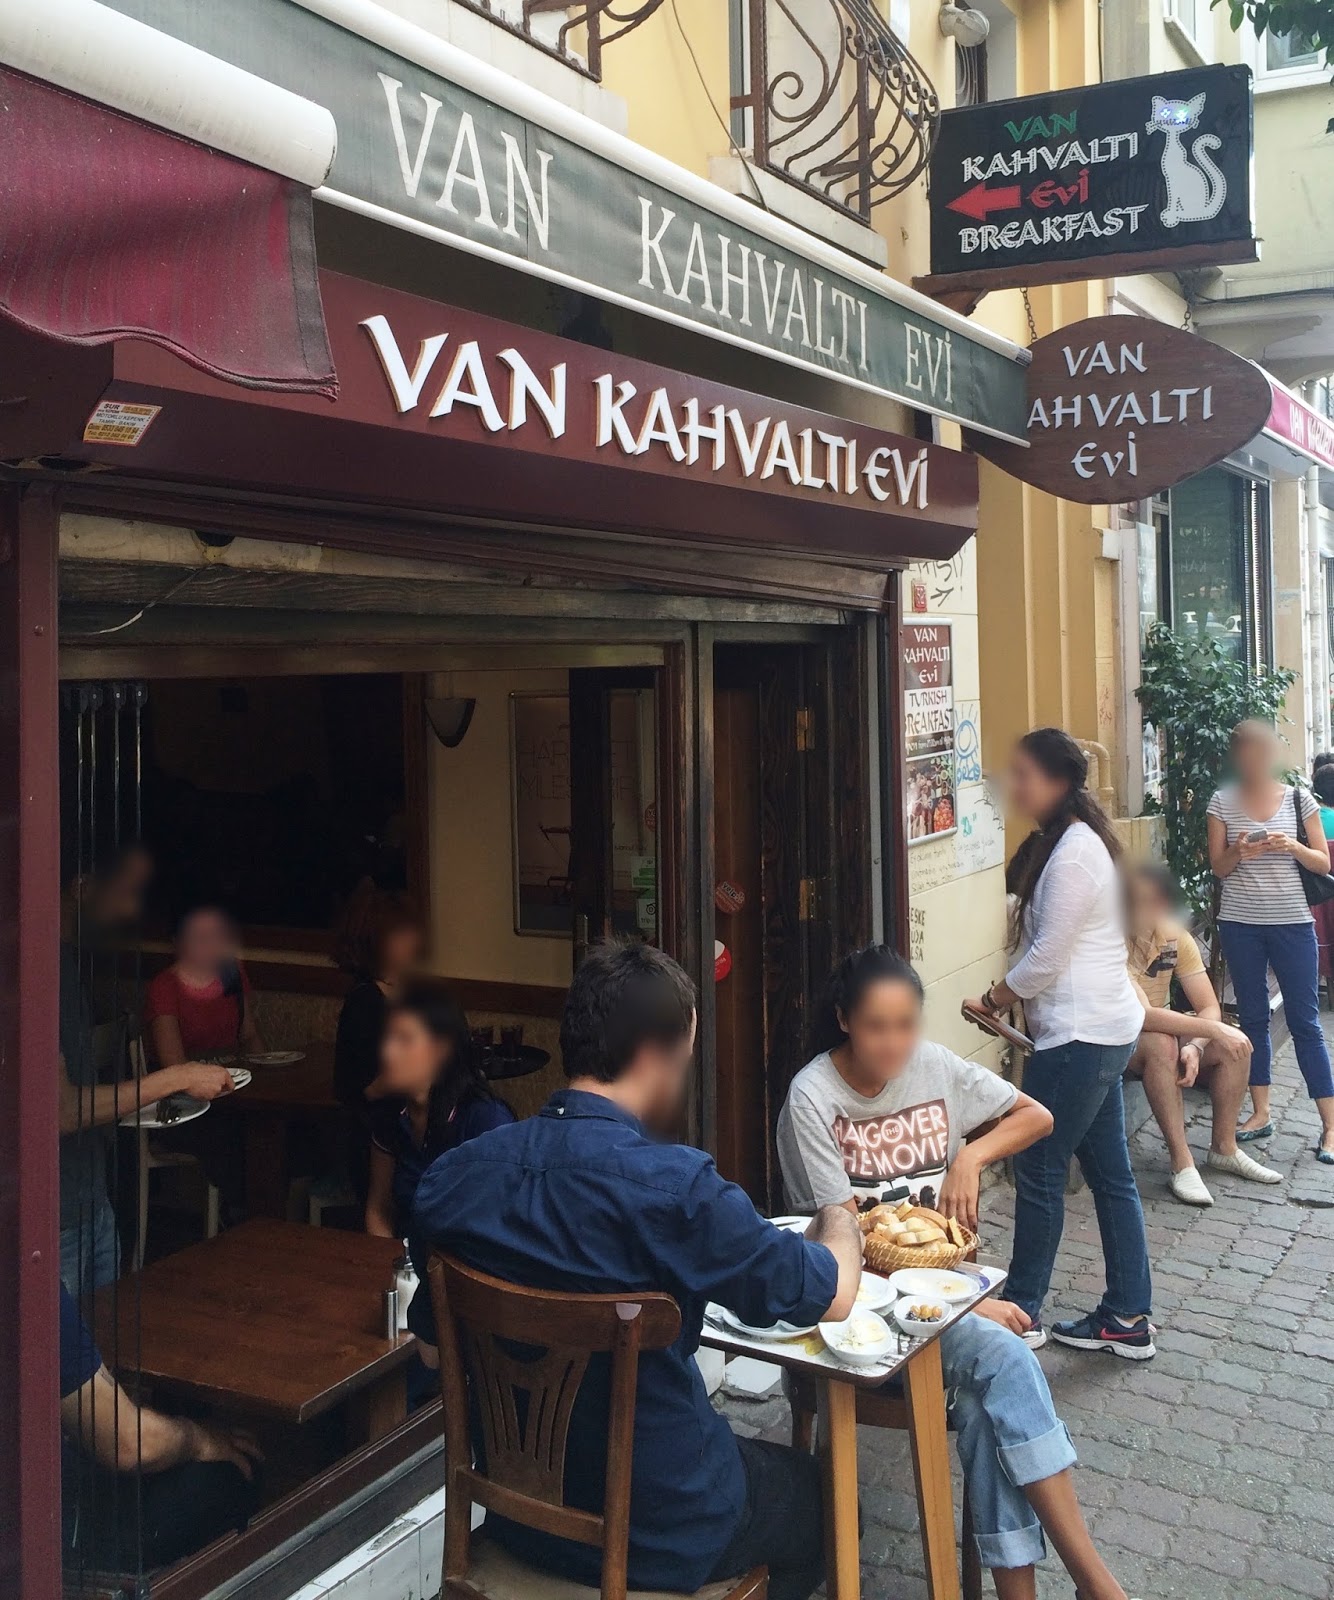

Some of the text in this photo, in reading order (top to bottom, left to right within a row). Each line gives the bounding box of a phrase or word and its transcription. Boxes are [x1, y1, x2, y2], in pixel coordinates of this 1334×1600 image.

[1004, 110, 1077, 143] VAN
[961, 132, 1138, 182] KAHVALTI
[377, 72, 953, 404] VAN KAHVALTI EVİ
[958, 204, 1149, 253] BREAKFAST
[1062, 340, 1148, 377] VAN
[358, 314, 566, 439] VAN
[593, 374, 857, 494] KAHVALTI
[1027, 386, 1214, 429] AHVALTI
[913, 628, 938, 643] VAN
[909, 690, 947, 707] TURKISH
[905, 708, 953, 735] REAKFAST
[885, 1125, 899, 1136] THE
